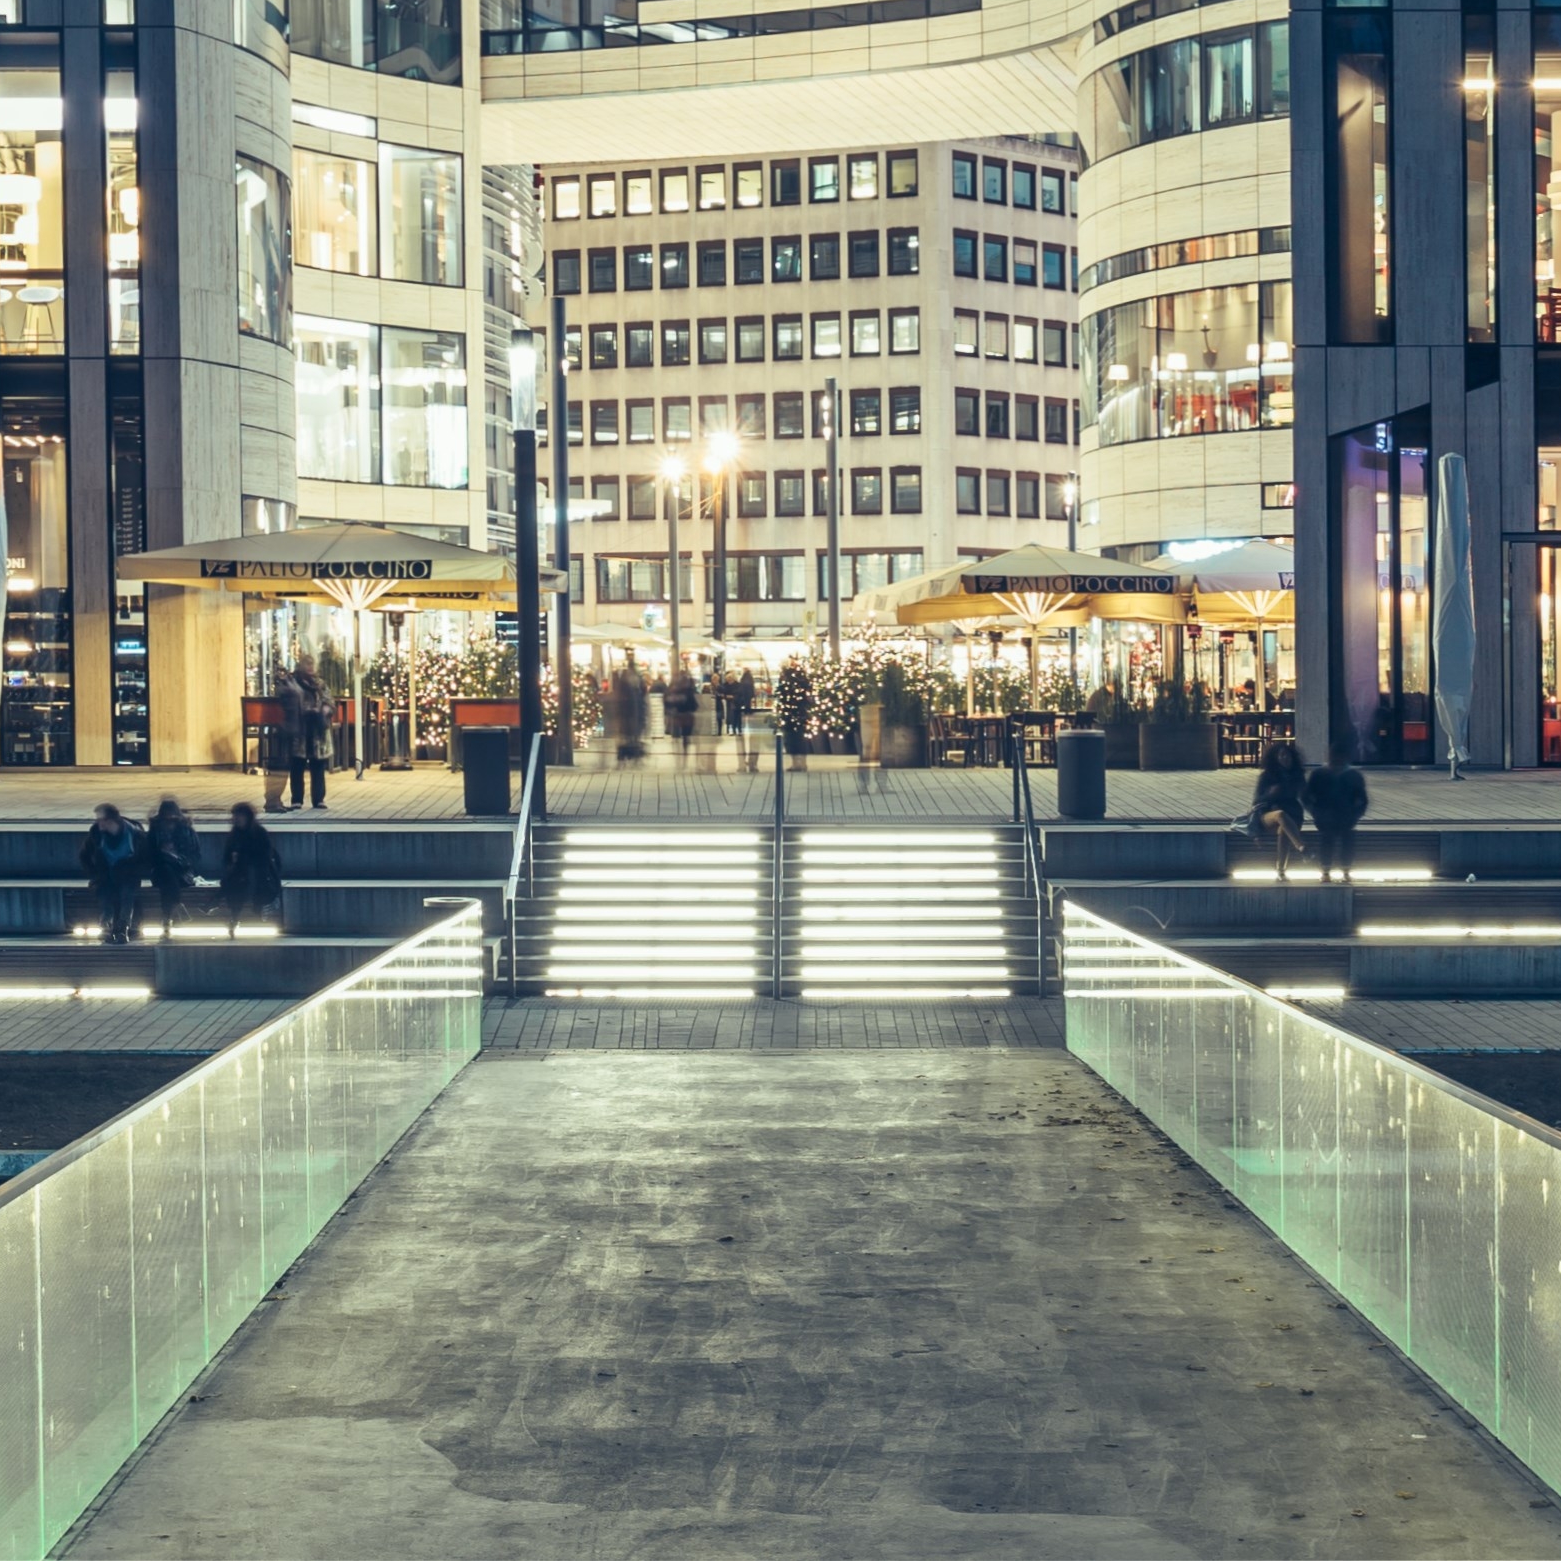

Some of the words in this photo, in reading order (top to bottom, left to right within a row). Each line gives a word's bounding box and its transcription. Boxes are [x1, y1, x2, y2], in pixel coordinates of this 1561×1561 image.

[241, 560, 309, 578] PALIO
[314, 560, 429, 579] POCCINO
[1009, 576, 1069, 592] PALIO
[1073, 575, 1172, 593] POCCINO
